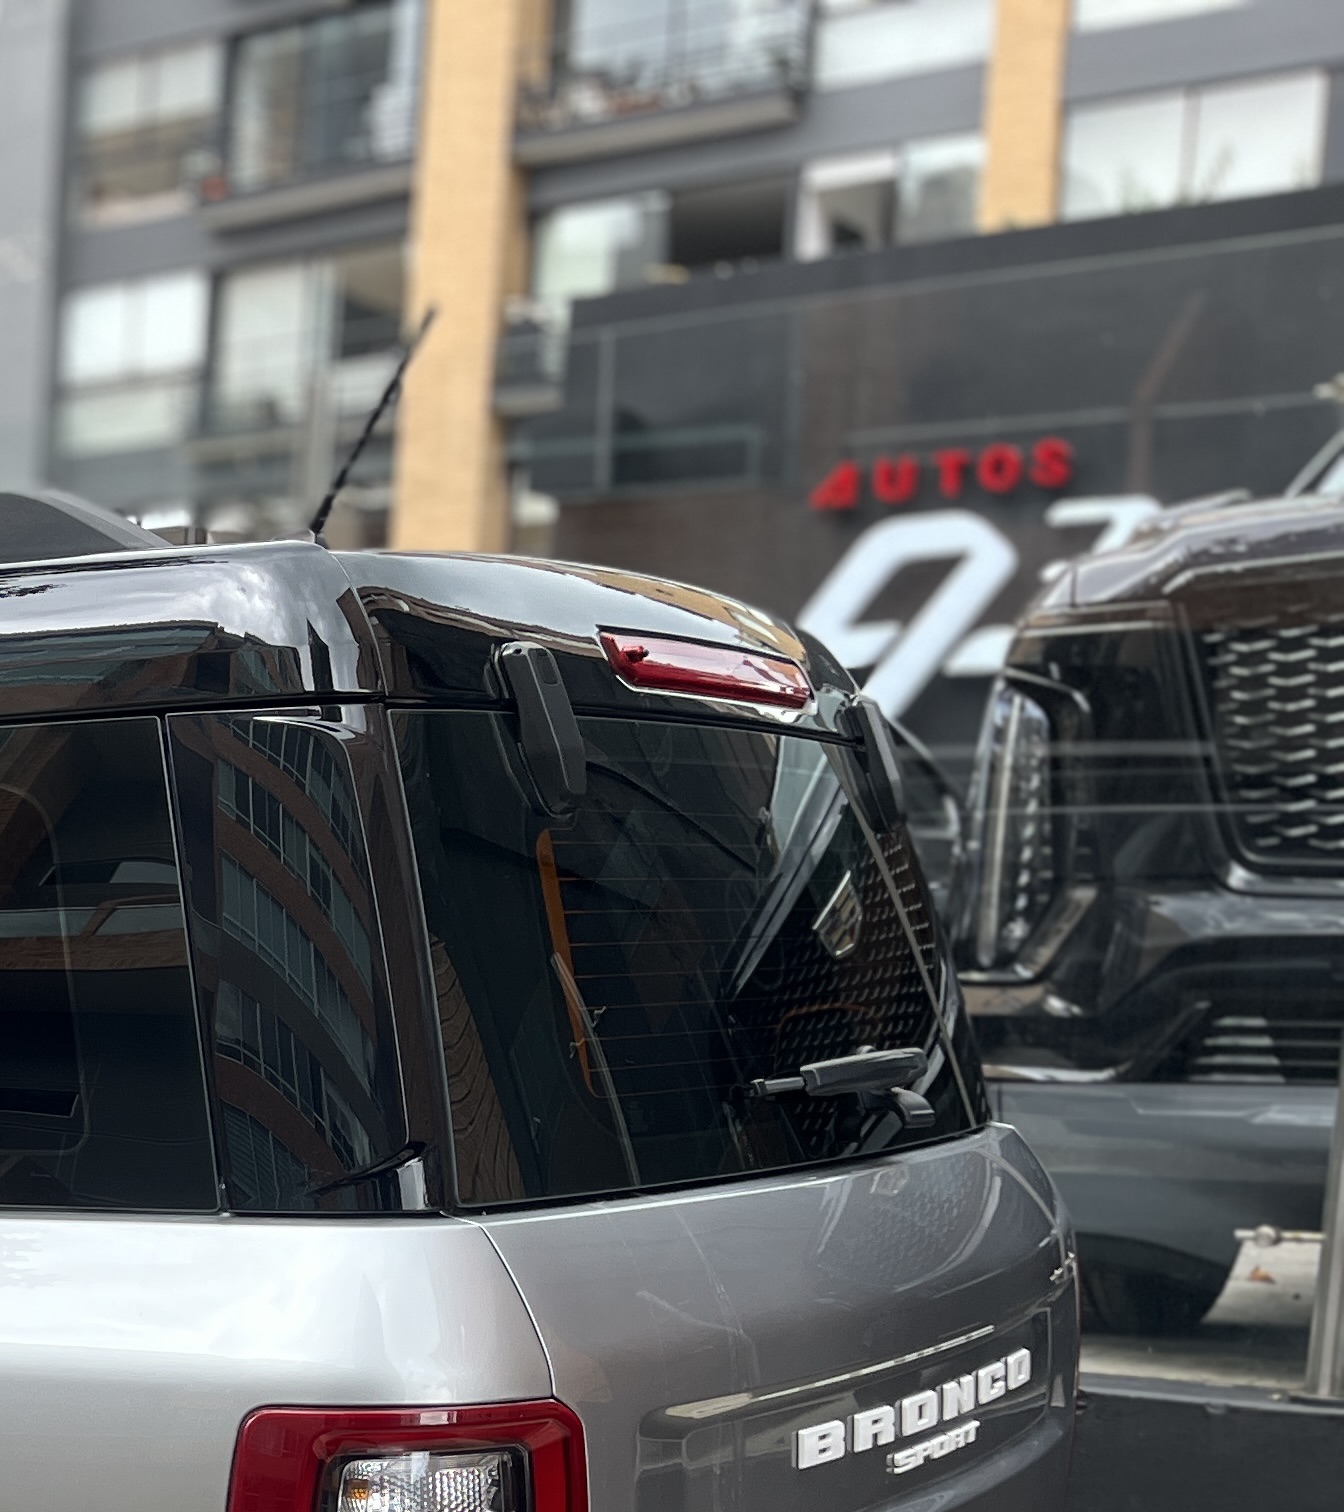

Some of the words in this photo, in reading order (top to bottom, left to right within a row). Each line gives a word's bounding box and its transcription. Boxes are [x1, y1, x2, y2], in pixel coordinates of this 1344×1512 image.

[810, 438, 1072, 508] AUTOS
[793, 1347, 1032, 1471] BRONCO
[886, 1419, 981, 1475] SPORT
